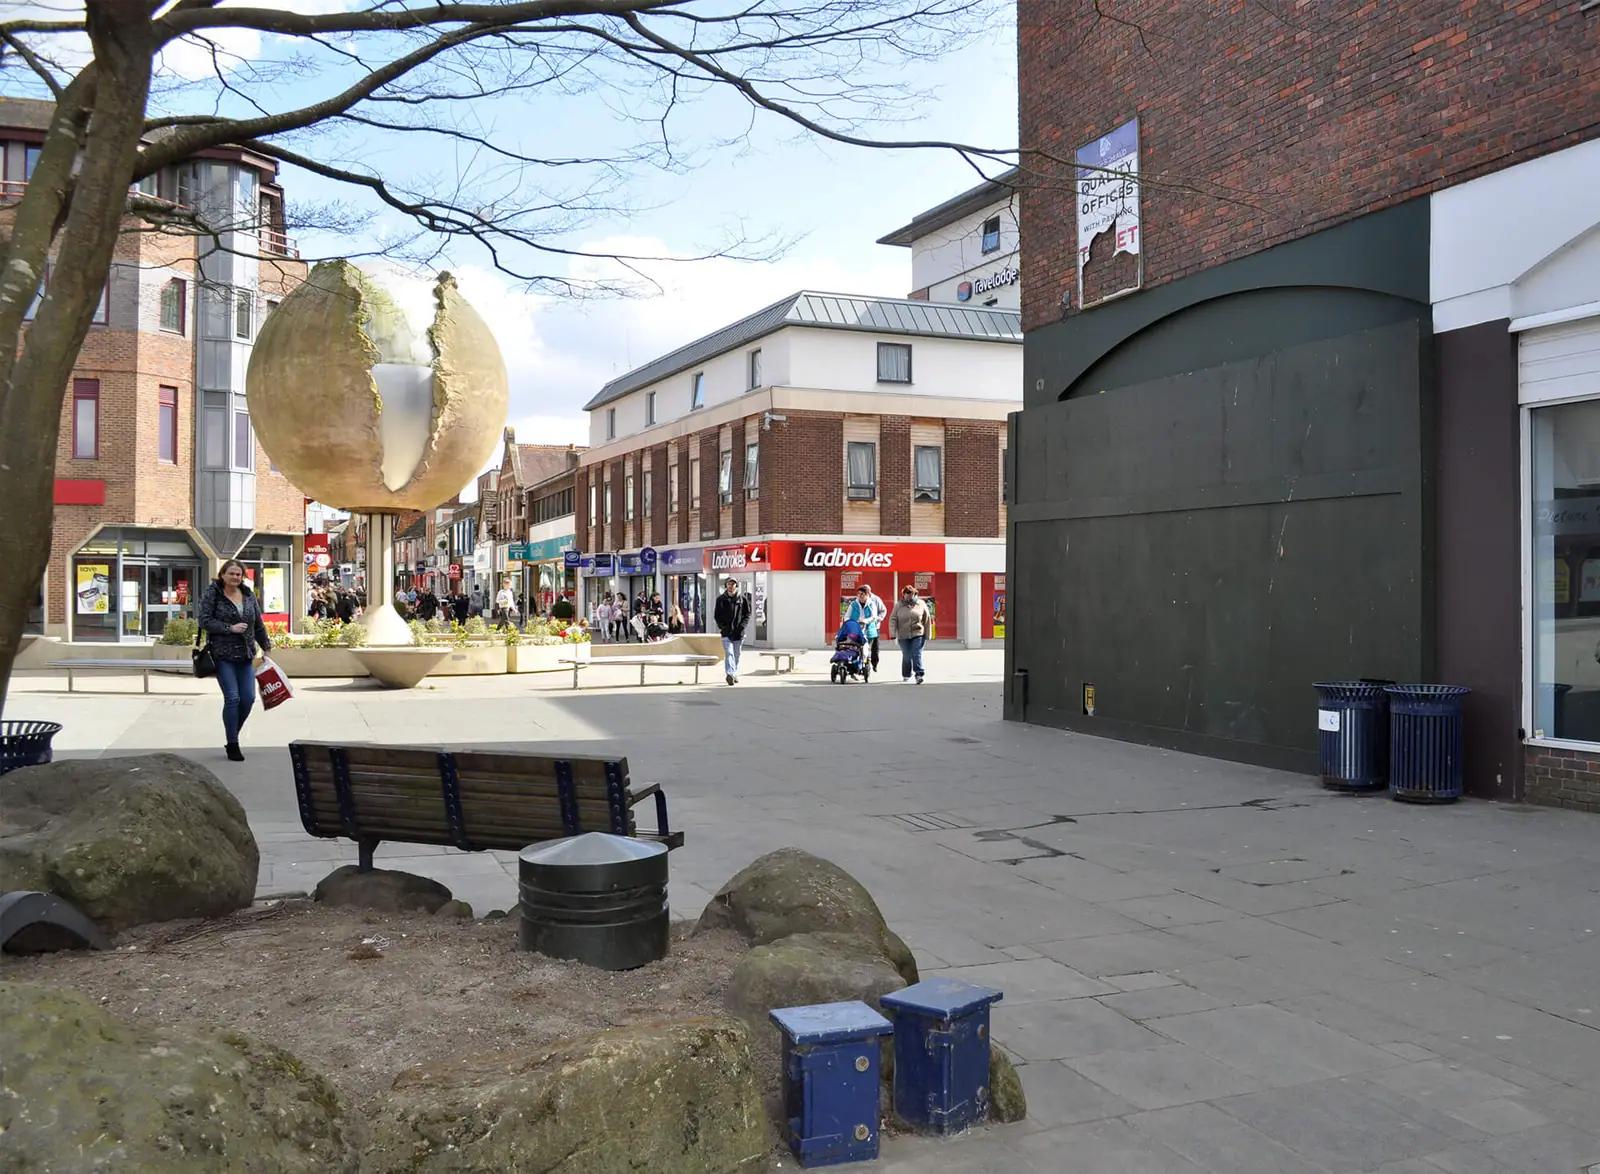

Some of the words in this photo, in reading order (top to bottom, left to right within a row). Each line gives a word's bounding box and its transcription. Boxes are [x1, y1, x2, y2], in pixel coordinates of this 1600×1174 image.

[1081, 159, 1132, 195] QUALITY
[1082, 181, 1134, 215] OFFICES
[1083, 219, 1100, 233] WITH
[973, 265, 1018, 294] Travelodge
[307, 545, 327, 553] wilko
[711, 549, 747, 569] Ladbrokes
[804, 547, 894, 568] Ladbrokes
